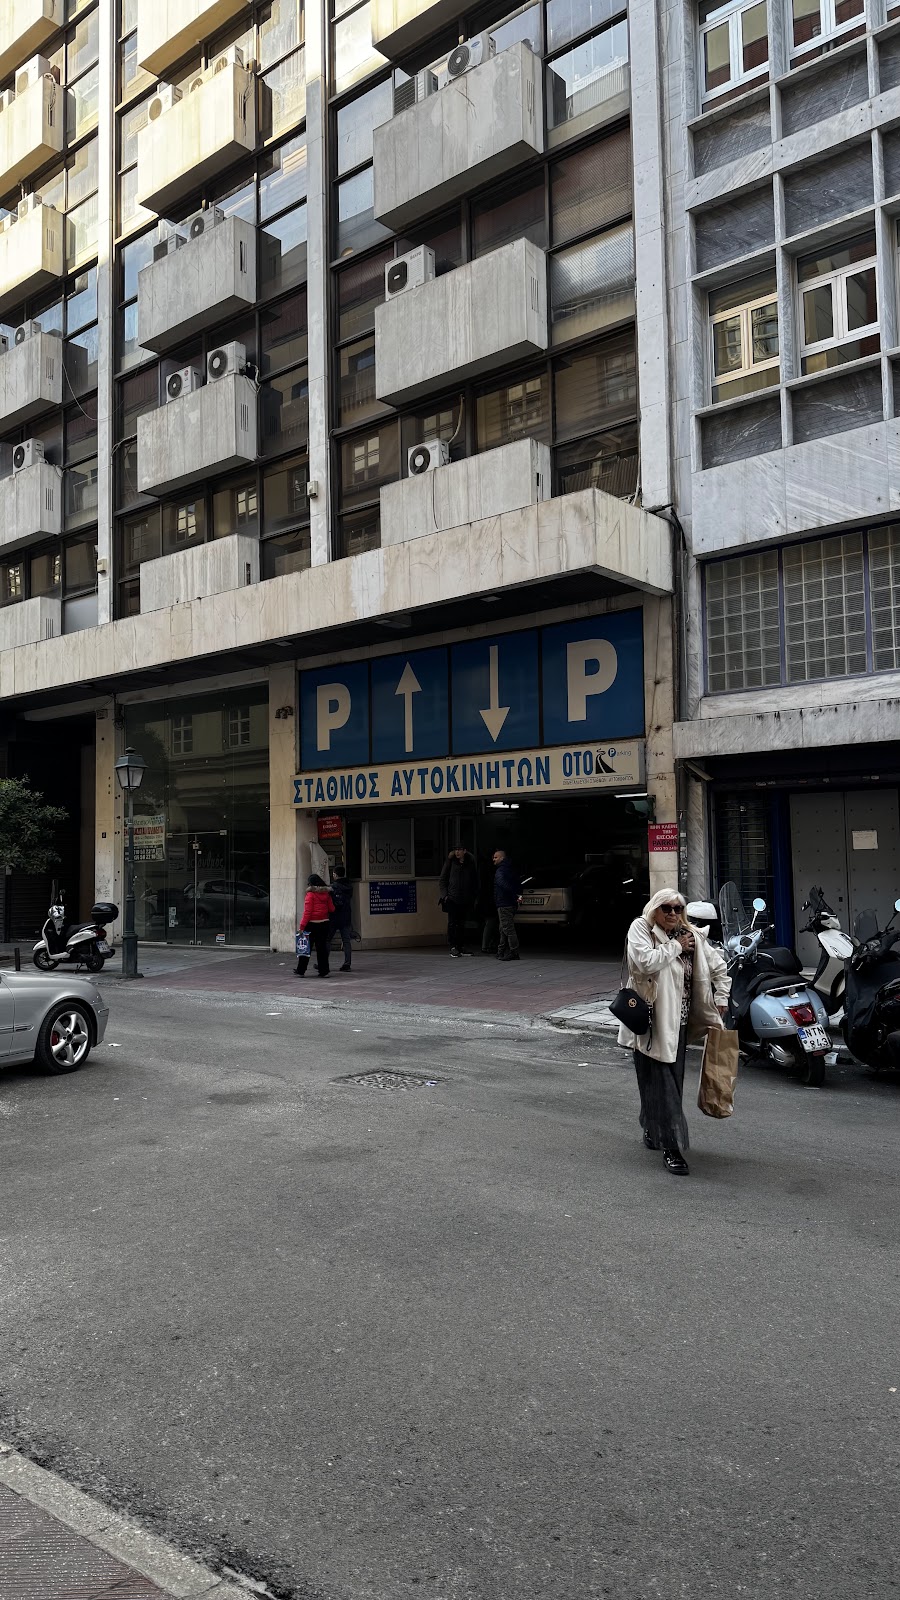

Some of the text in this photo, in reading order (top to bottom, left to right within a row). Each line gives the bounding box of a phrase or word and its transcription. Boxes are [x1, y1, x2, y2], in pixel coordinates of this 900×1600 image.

[566, 638, 618, 722] P
[316, 683, 351, 751] P
[293, 755, 551, 804] ΣΤΑΘΜΟΣ ΑΥΤΟΚΙΝΗΤΩΝ
[563, 750, 593, 777] OTO
[804, 1026, 825, 1037] NTN
